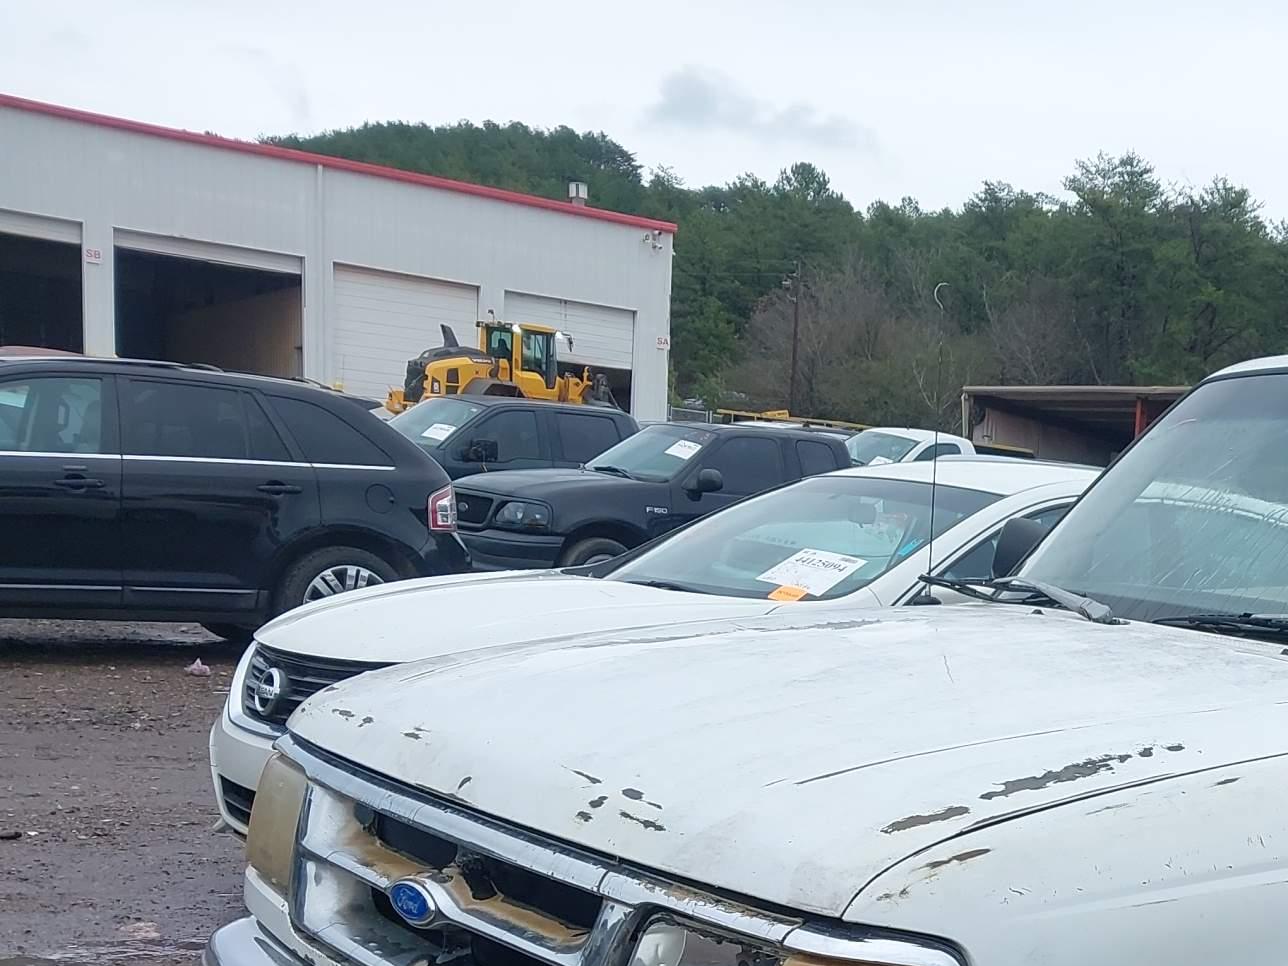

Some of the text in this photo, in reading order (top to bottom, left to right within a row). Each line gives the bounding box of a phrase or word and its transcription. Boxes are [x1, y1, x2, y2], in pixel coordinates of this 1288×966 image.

[86, 248, 101, 259] SB
[657, 337, 669, 345] SA
[397, 887, 422, 914] Ford
